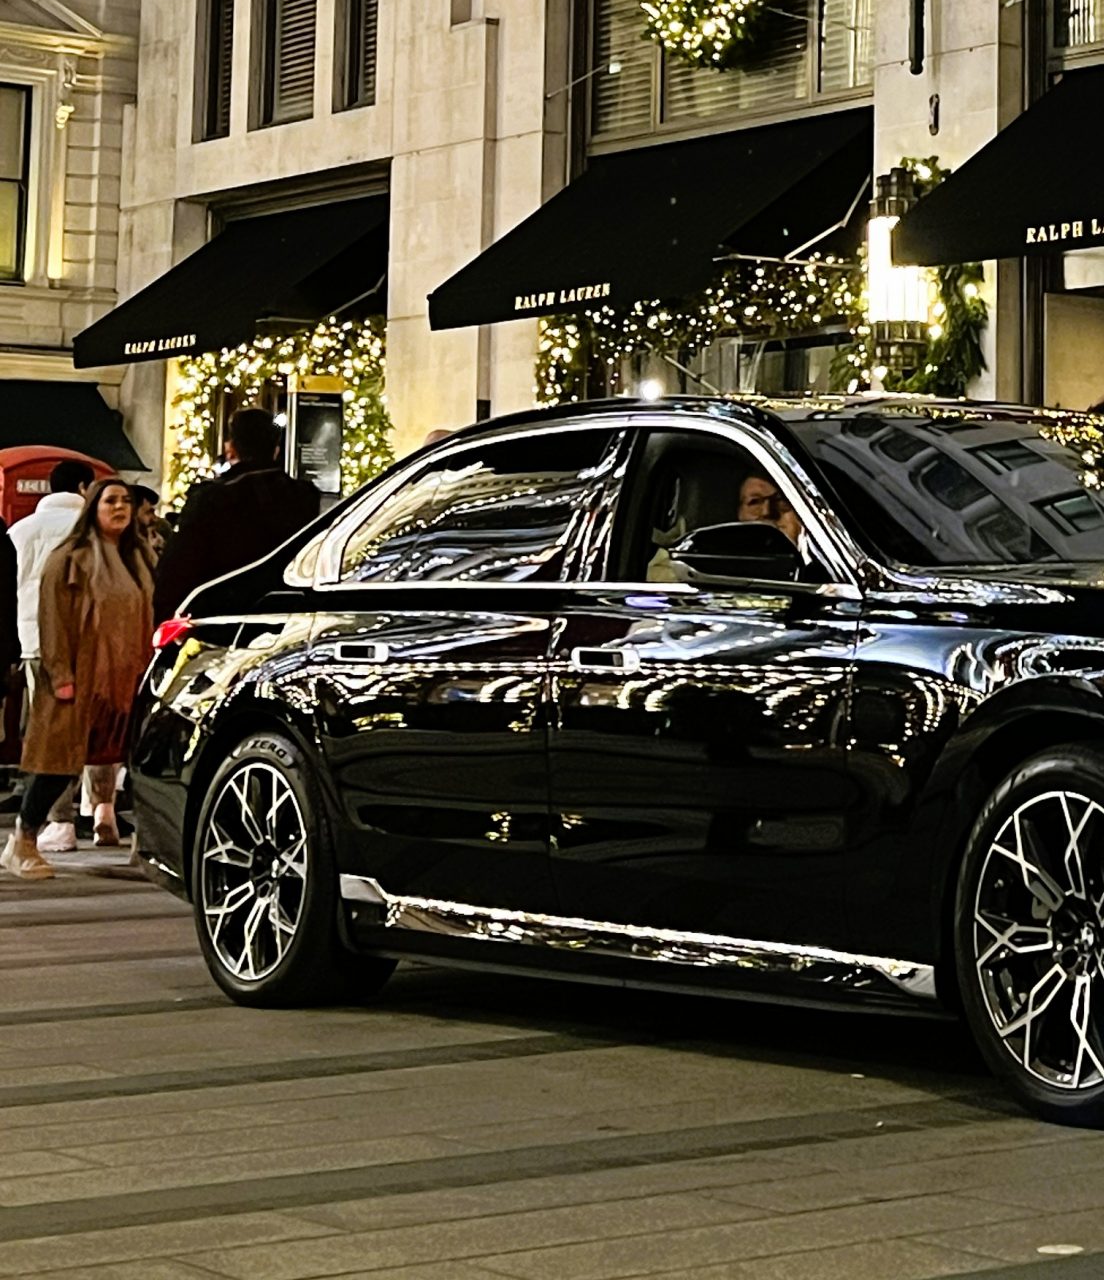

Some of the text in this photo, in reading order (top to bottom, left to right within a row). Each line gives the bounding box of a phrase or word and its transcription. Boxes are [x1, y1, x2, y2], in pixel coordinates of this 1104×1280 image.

[1026, 221, 1083, 244] RALPH
[515, 283, 611, 310] RALPH LAUREN
